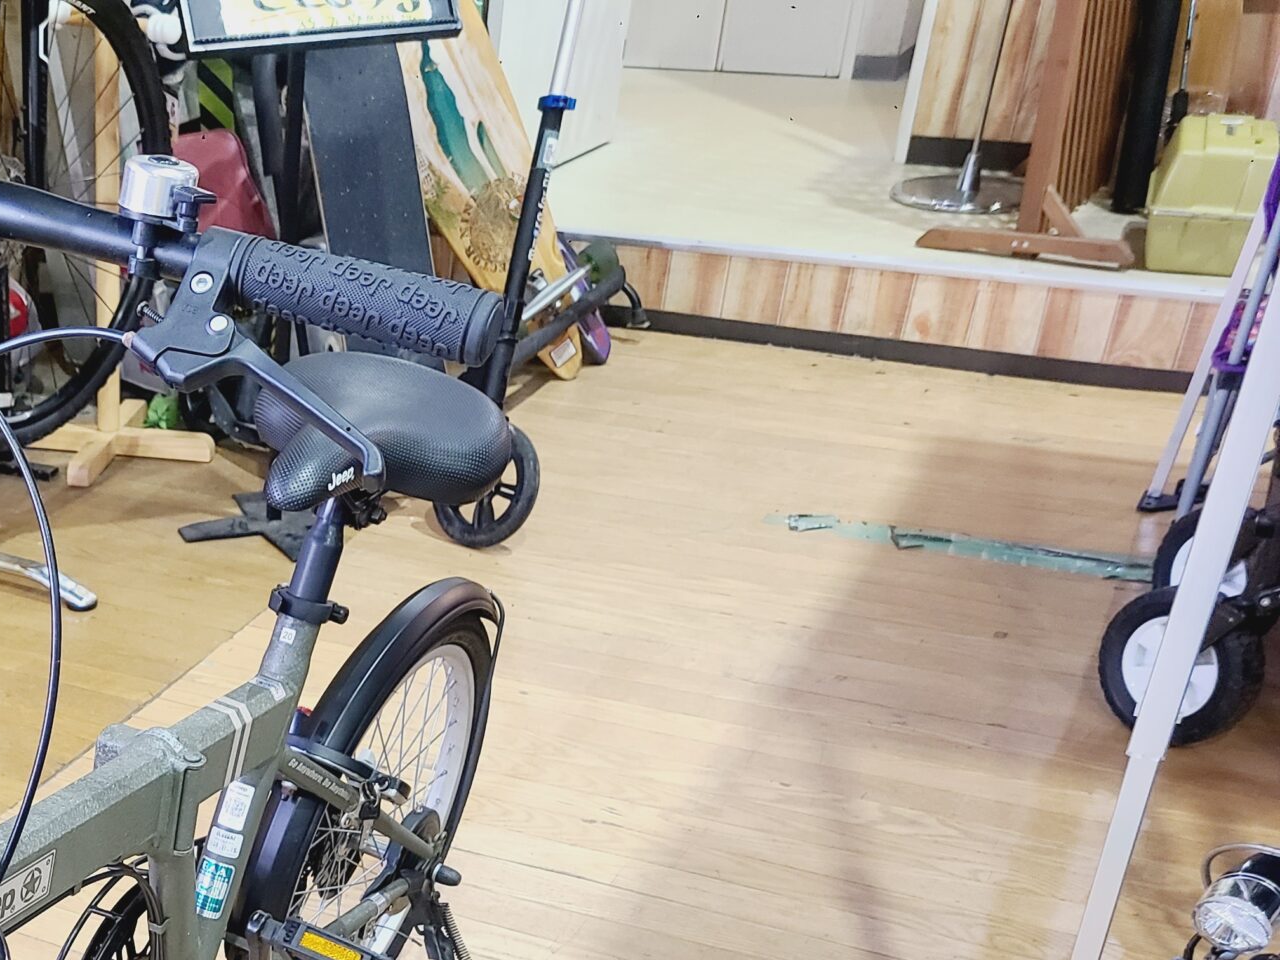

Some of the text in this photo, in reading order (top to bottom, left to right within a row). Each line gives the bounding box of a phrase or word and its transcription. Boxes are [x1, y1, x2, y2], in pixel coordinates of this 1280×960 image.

[255, 260, 317, 304] Jeep
[331, 261, 392, 296] Jeep
[398, 282, 458, 331] Jeep
[322, 283, 384, 330] Jeep
[328, 466, 354, 491] Jeep
[282, 630, 293, 641] 20
